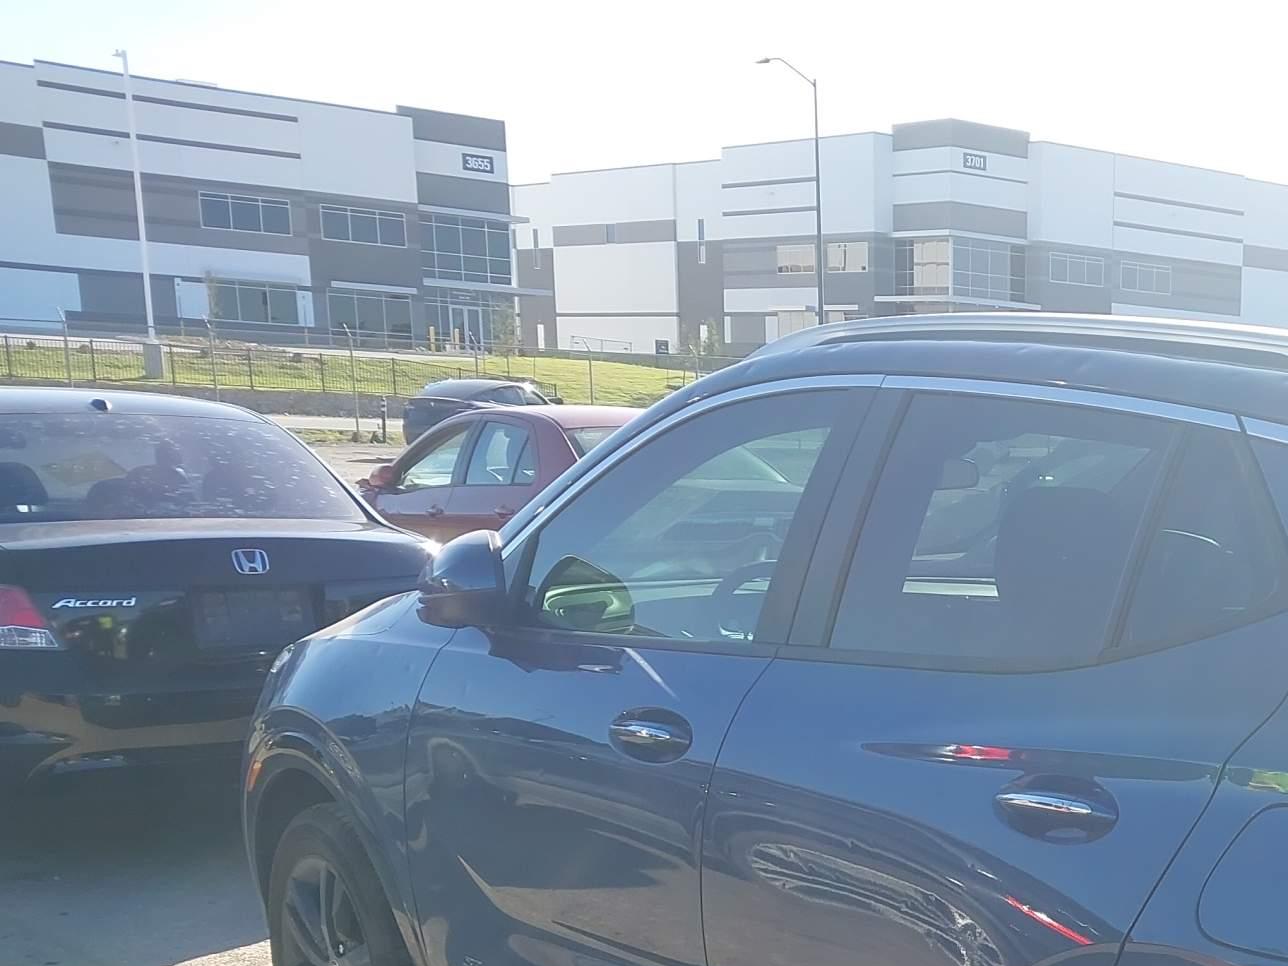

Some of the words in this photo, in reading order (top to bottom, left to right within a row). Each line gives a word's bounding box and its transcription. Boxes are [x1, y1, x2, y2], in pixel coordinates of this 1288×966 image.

[465, 156, 491, 171] 3655
[966, 155, 984, 169] 3701
[52, 597, 136, 609] Accord
